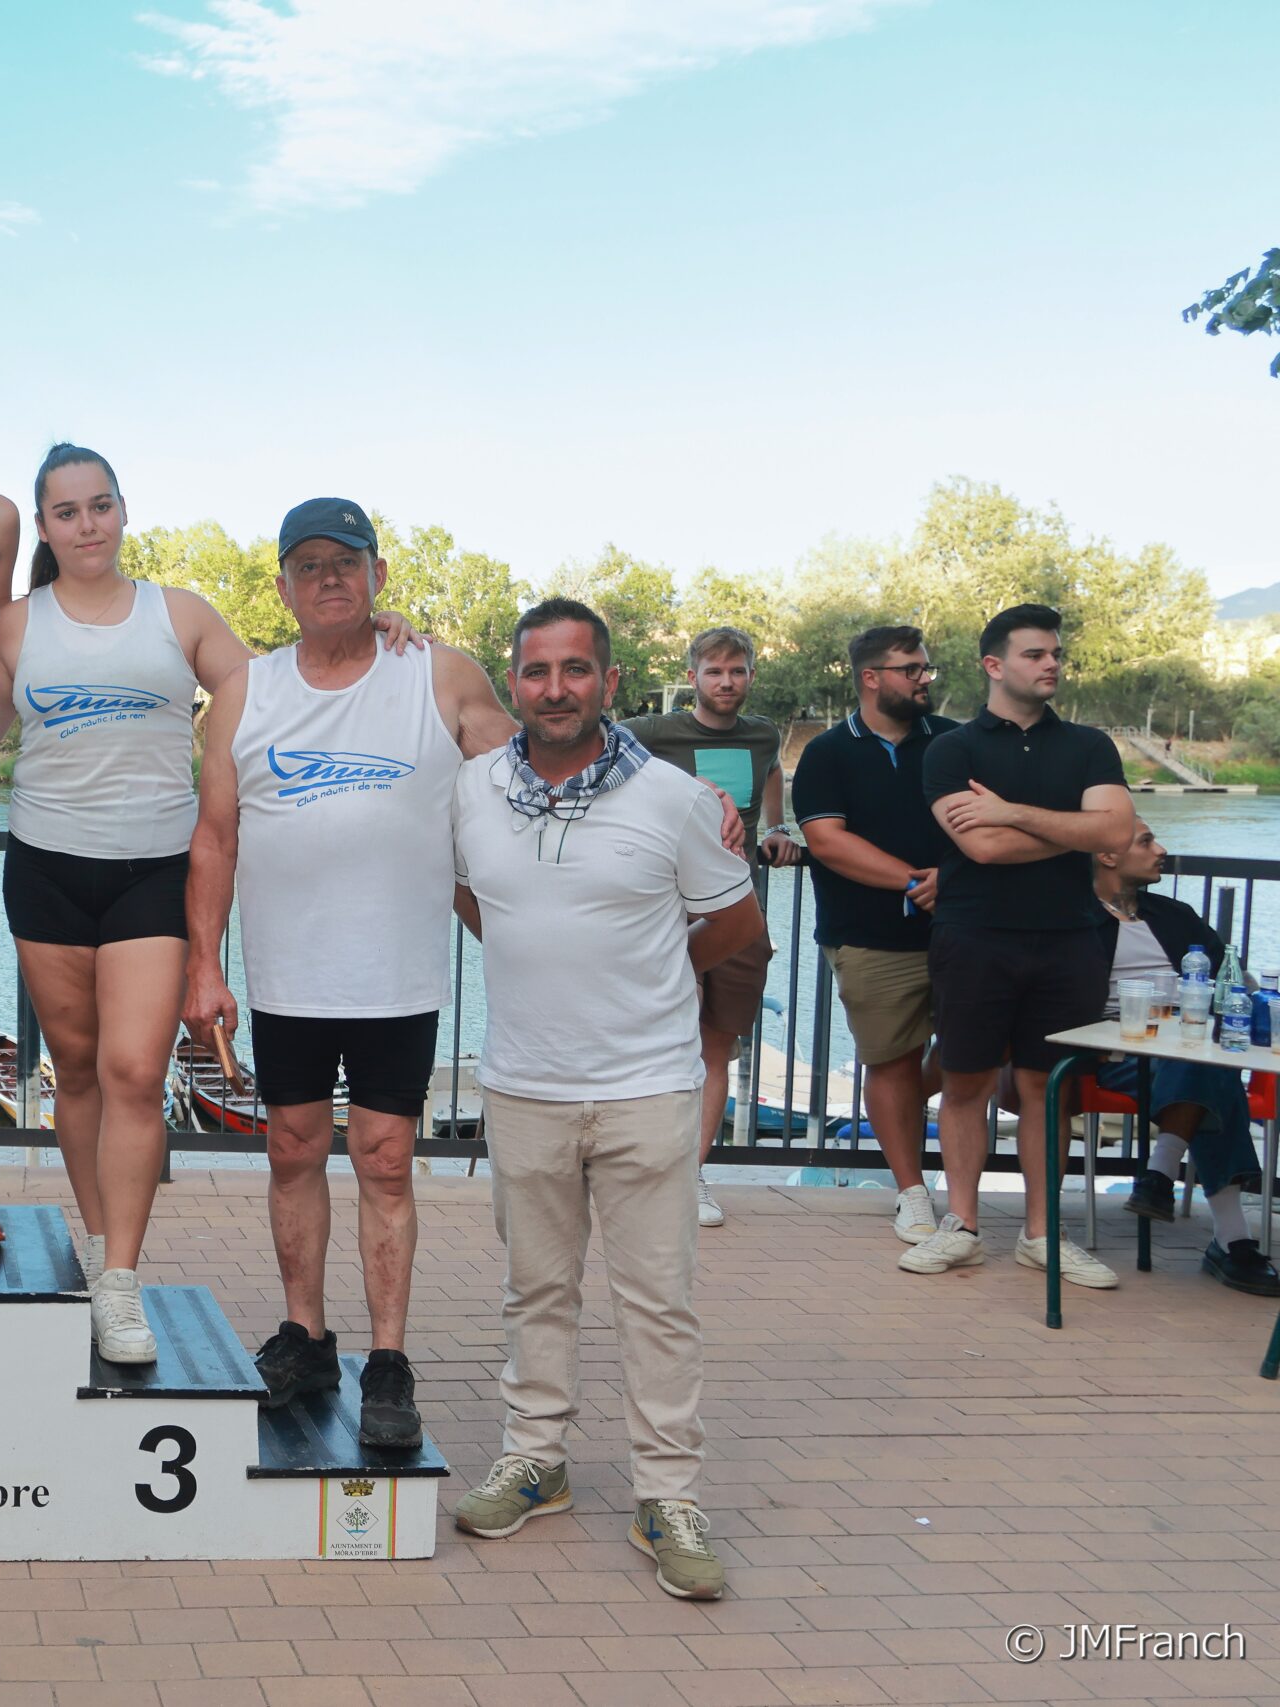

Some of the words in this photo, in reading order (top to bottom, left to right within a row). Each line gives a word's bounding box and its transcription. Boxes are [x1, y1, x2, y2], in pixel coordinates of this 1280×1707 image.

[60, 725, 79, 739] Club
[115, 712, 127, 721] de
[296, 793, 318, 807] Club
[320, 785, 350, 798] nàutic
[358, 781, 371, 790] de
[134, 1424, 197, 1514] 3
